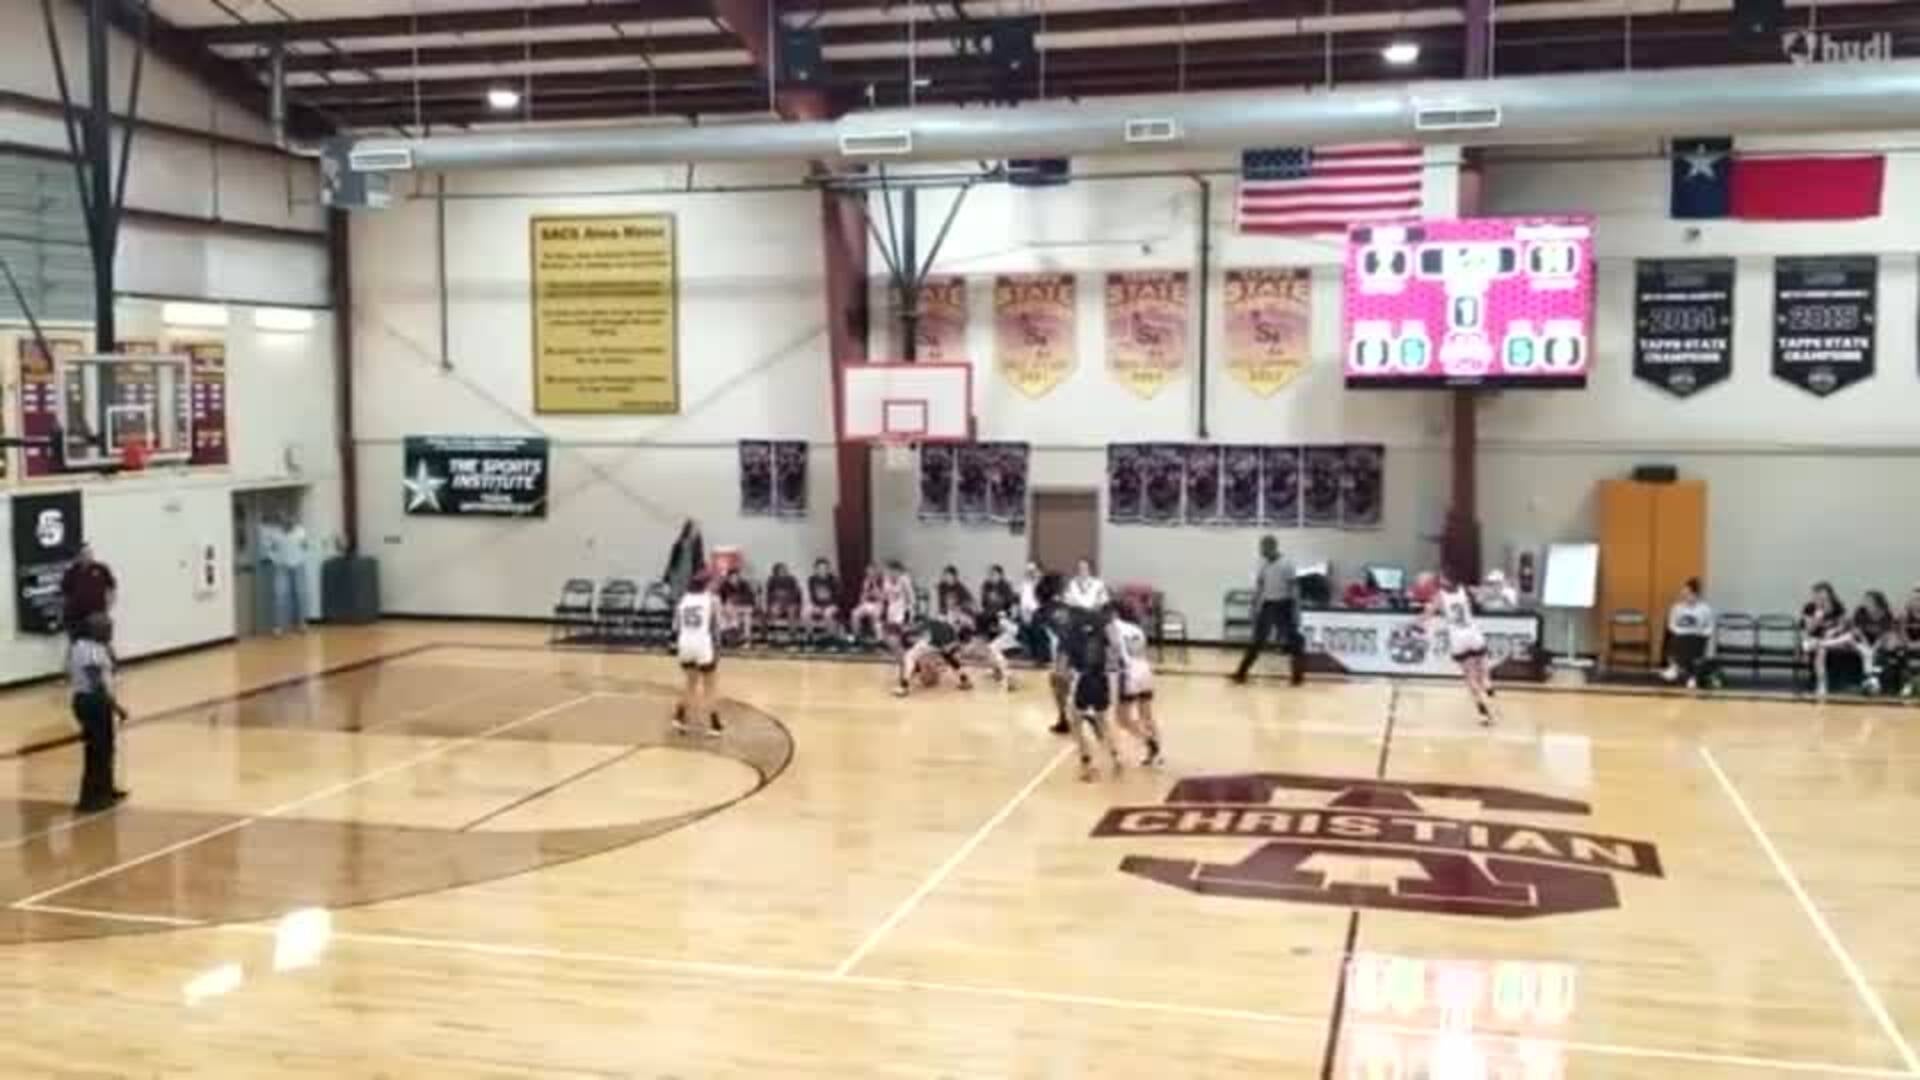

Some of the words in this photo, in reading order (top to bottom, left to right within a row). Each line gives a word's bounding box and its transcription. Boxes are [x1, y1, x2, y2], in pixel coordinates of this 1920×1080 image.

[995, 282, 1075, 303] STATE
[1105, 281, 1188, 302] STATE
[1223, 280, 1312, 303] STATE
[449, 458, 479, 473] THE
[480, 458, 543, 474] SPORTS
[451, 474, 537, 490] INSTITUTE
[1115, 808, 1638, 868] CHRISTIAN
